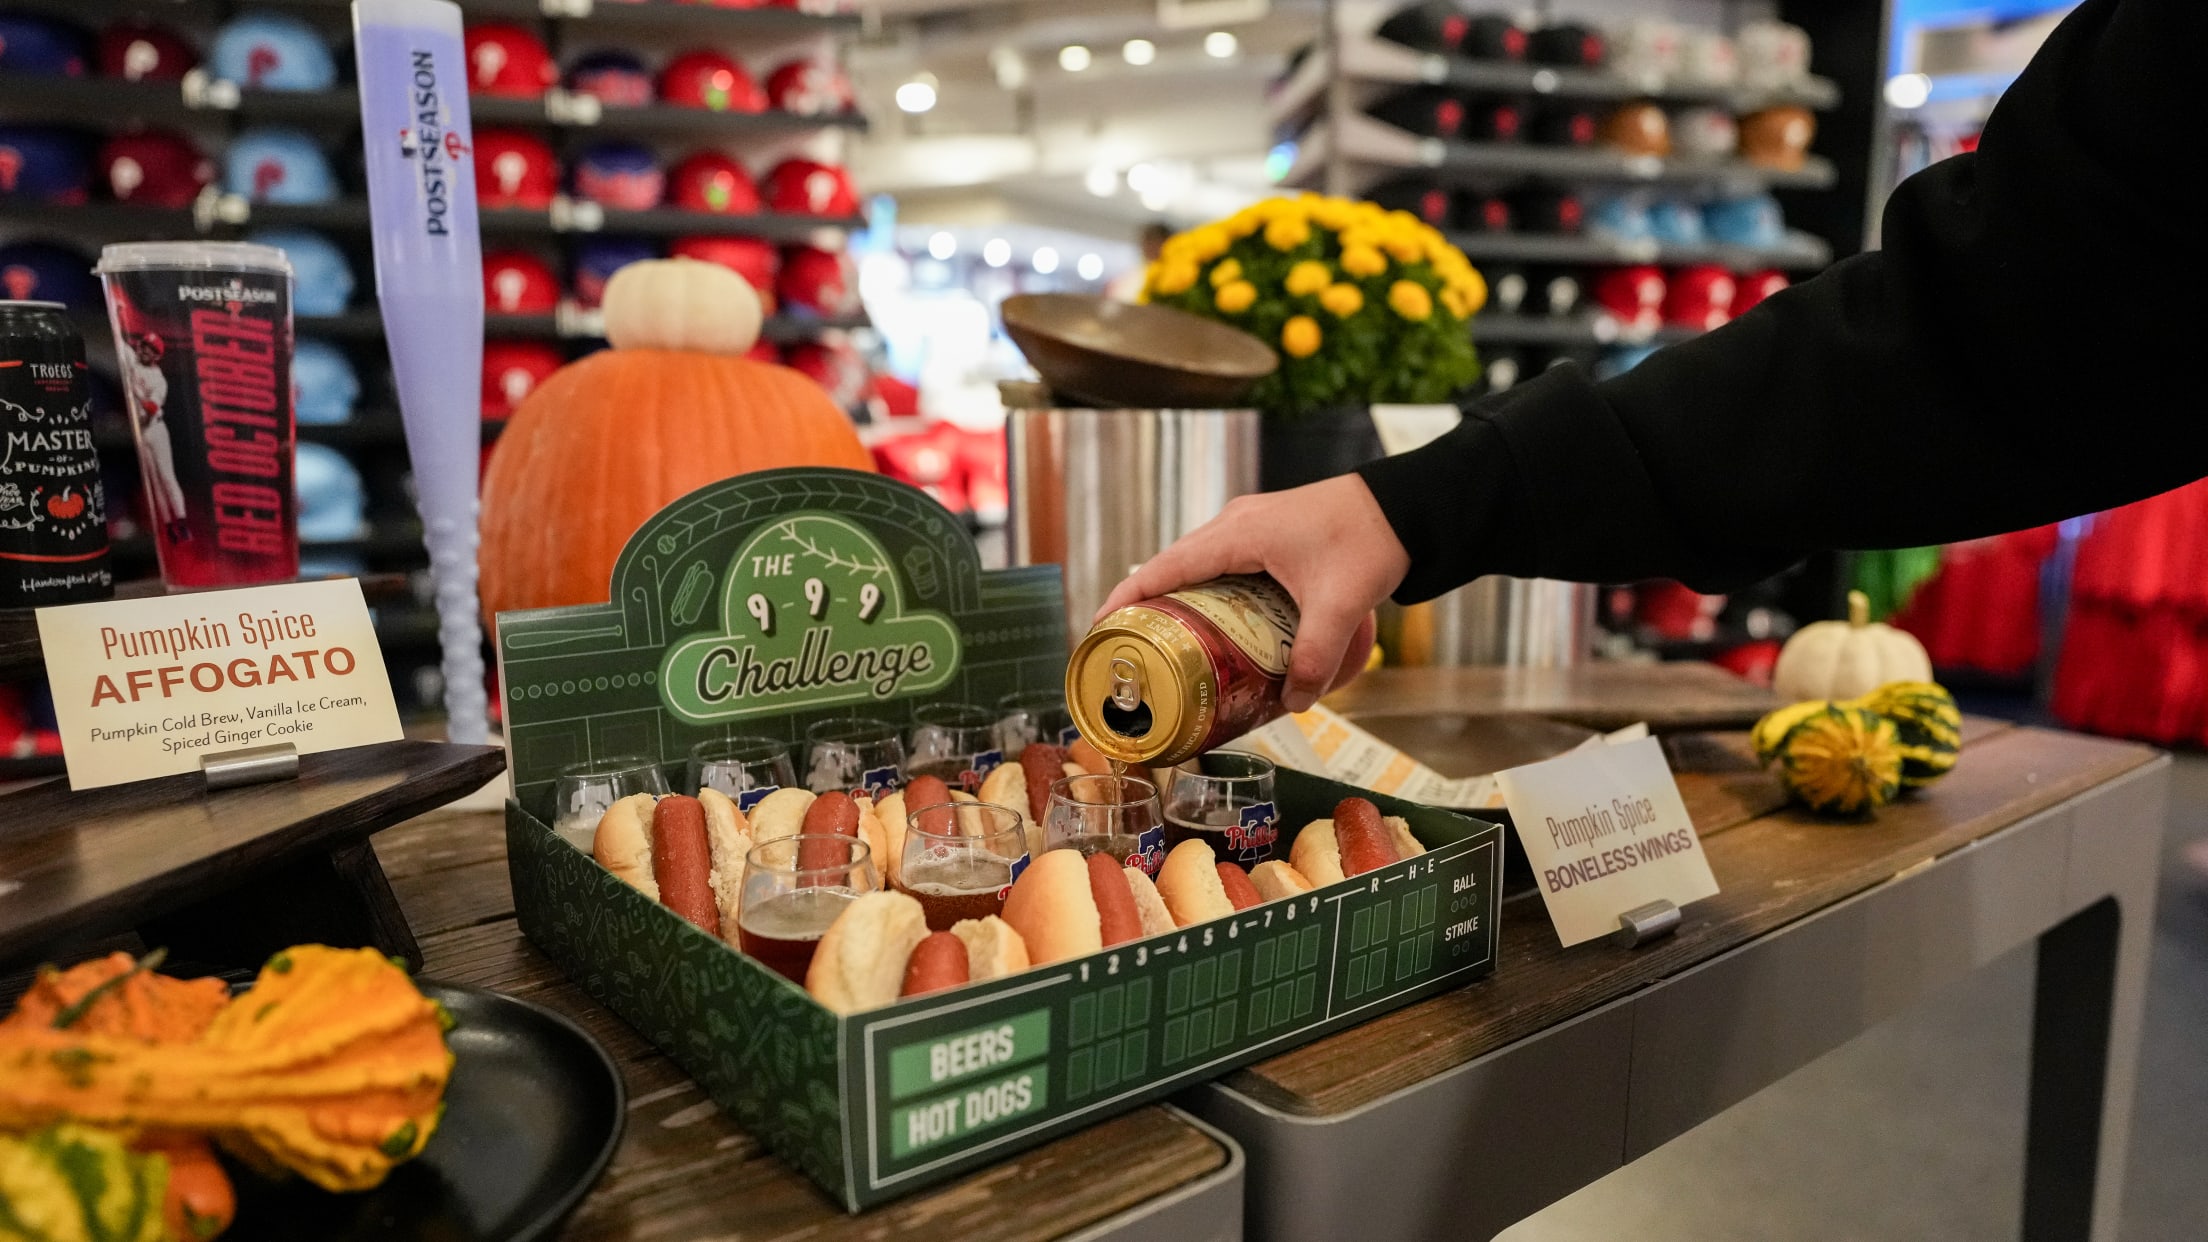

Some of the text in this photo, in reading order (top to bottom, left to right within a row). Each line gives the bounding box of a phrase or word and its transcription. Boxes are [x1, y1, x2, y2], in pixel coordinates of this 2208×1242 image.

[412, 50, 449, 237] POSTSEASON
[8, 429, 92, 452] MASTER
[191, 307, 284, 556] RED OCTOBER
[752, 554, 795, 578] THE
[100, 608, 317, 660] Pumpkin Spice
[90, 646, 356, 707] AFFOGATO
[696, 625, 934, 704] Challenge
[90, 693, 368, 743] Pumpkin Cold Brew, Vanilla Ice Cream,
[162, 718, 314, 753] Spiced Ginger Cookie
[1167, 682, 1208, 762] AMERICAN OWNED
[1546, 795, 1656, 849] Pumpkin Spice
[1453, 873, 1477, 894] BALL
[1544, 828, 1692, 893] BONELESS WINGS
[1080, 962, 1090, 982] 1
[1107, 954, 1120, 975] 2
[1136, 946, 1148, 966] 3
[1177, 935, 1188, 953] 4
[1203, 927, 1213, 946] 5
[1228, 920, 1239, 938] 6
[1264, 910, 1273, 928] 7
[1286, 903, 1296, 920] 8
[1310, 896, 1319, 914] 9
[1371, 877, 1379, 893] R
[1445, 915, 1479, 941] STRIKE
[930, 1024, 1015, 1082] BEERS
[908, 1074, 1033, 1149] HOT DOGS
